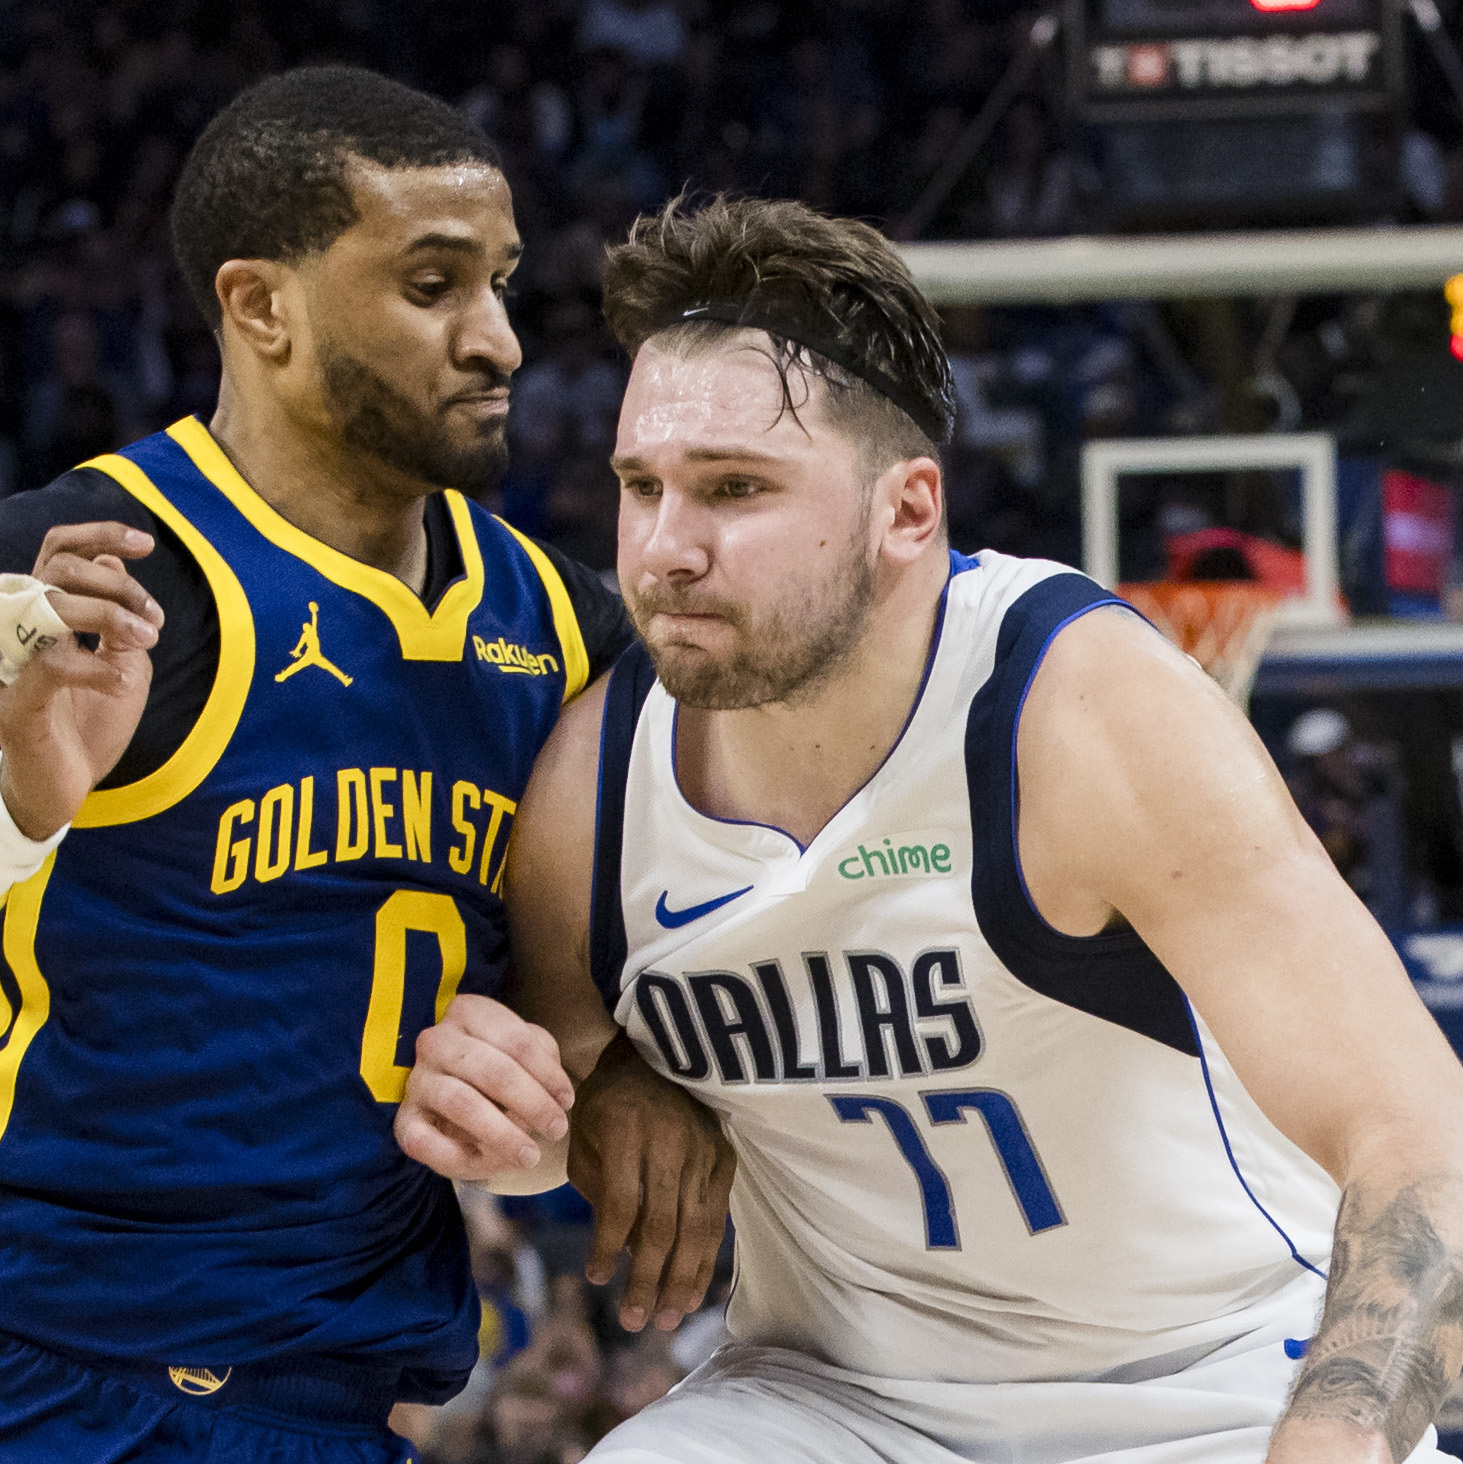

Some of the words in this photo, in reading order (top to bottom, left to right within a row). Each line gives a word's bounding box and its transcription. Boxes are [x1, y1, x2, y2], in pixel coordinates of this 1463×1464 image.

[210, 767, 434, 896] GOLDEN
[837, 838, 952, 880] chime
[359, 889, 467, 1104] 0
[635, 945, 987, 1085] DALLAS
[823, 1086, 1070, 1252] 77
